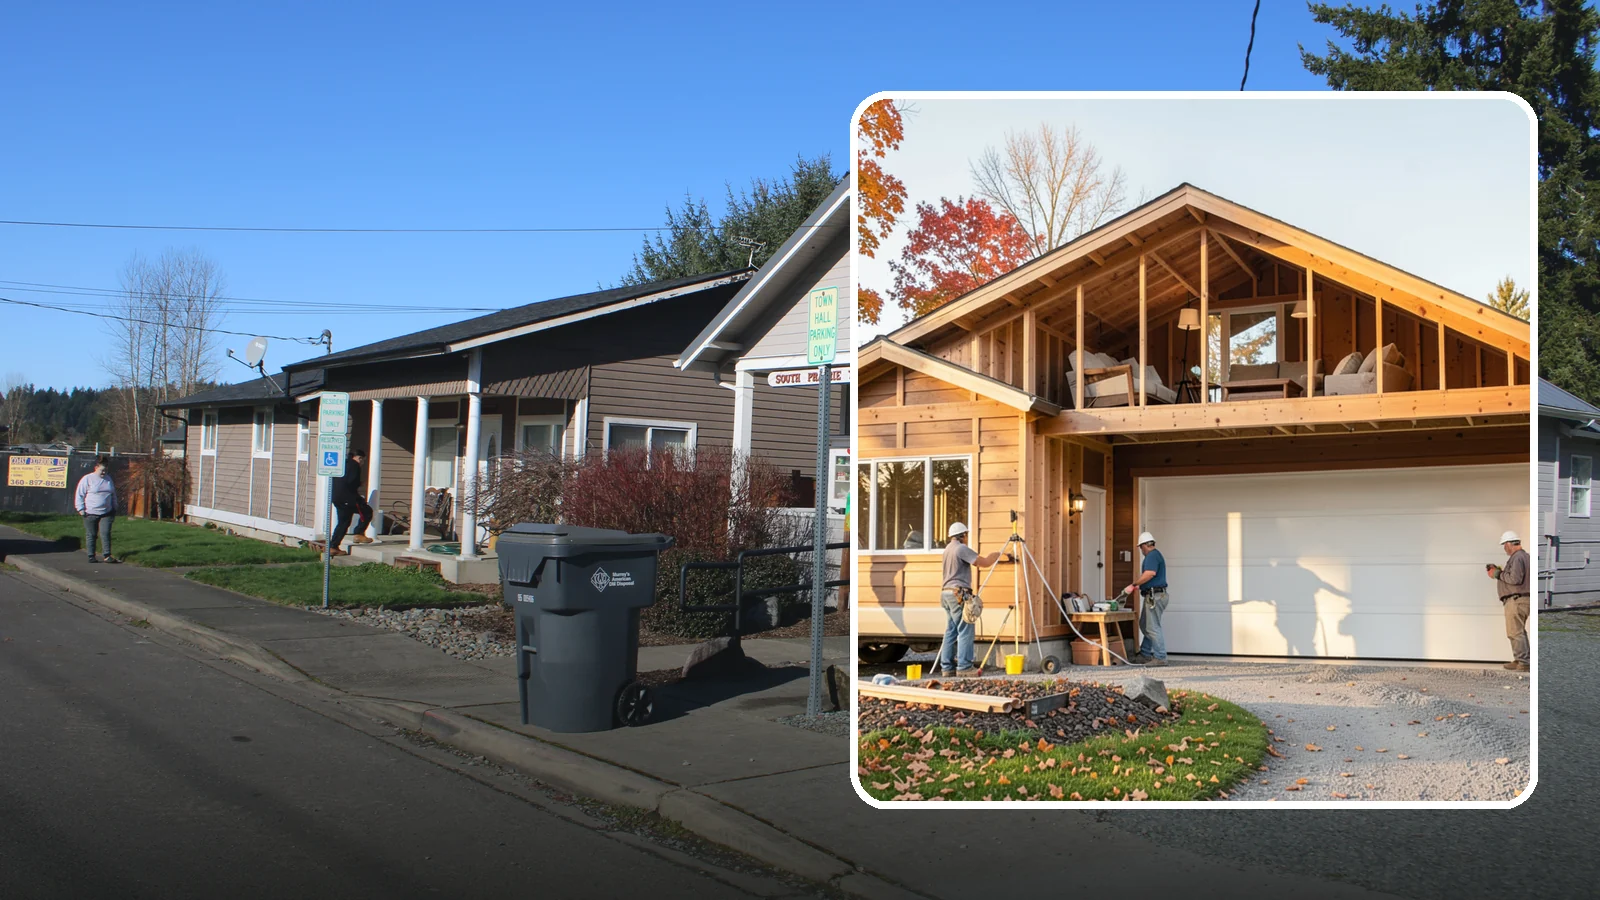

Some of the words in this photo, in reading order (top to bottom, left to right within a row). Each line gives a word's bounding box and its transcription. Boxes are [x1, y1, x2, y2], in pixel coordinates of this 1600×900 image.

[815, 294, 833, 308] TOWN
[814, 311, 831, 324] HALL
[810, 327, 835, 340] PARKING
[813, 344, 830, 357] ONLY
[775, 373, 801, 384] SOUTH
